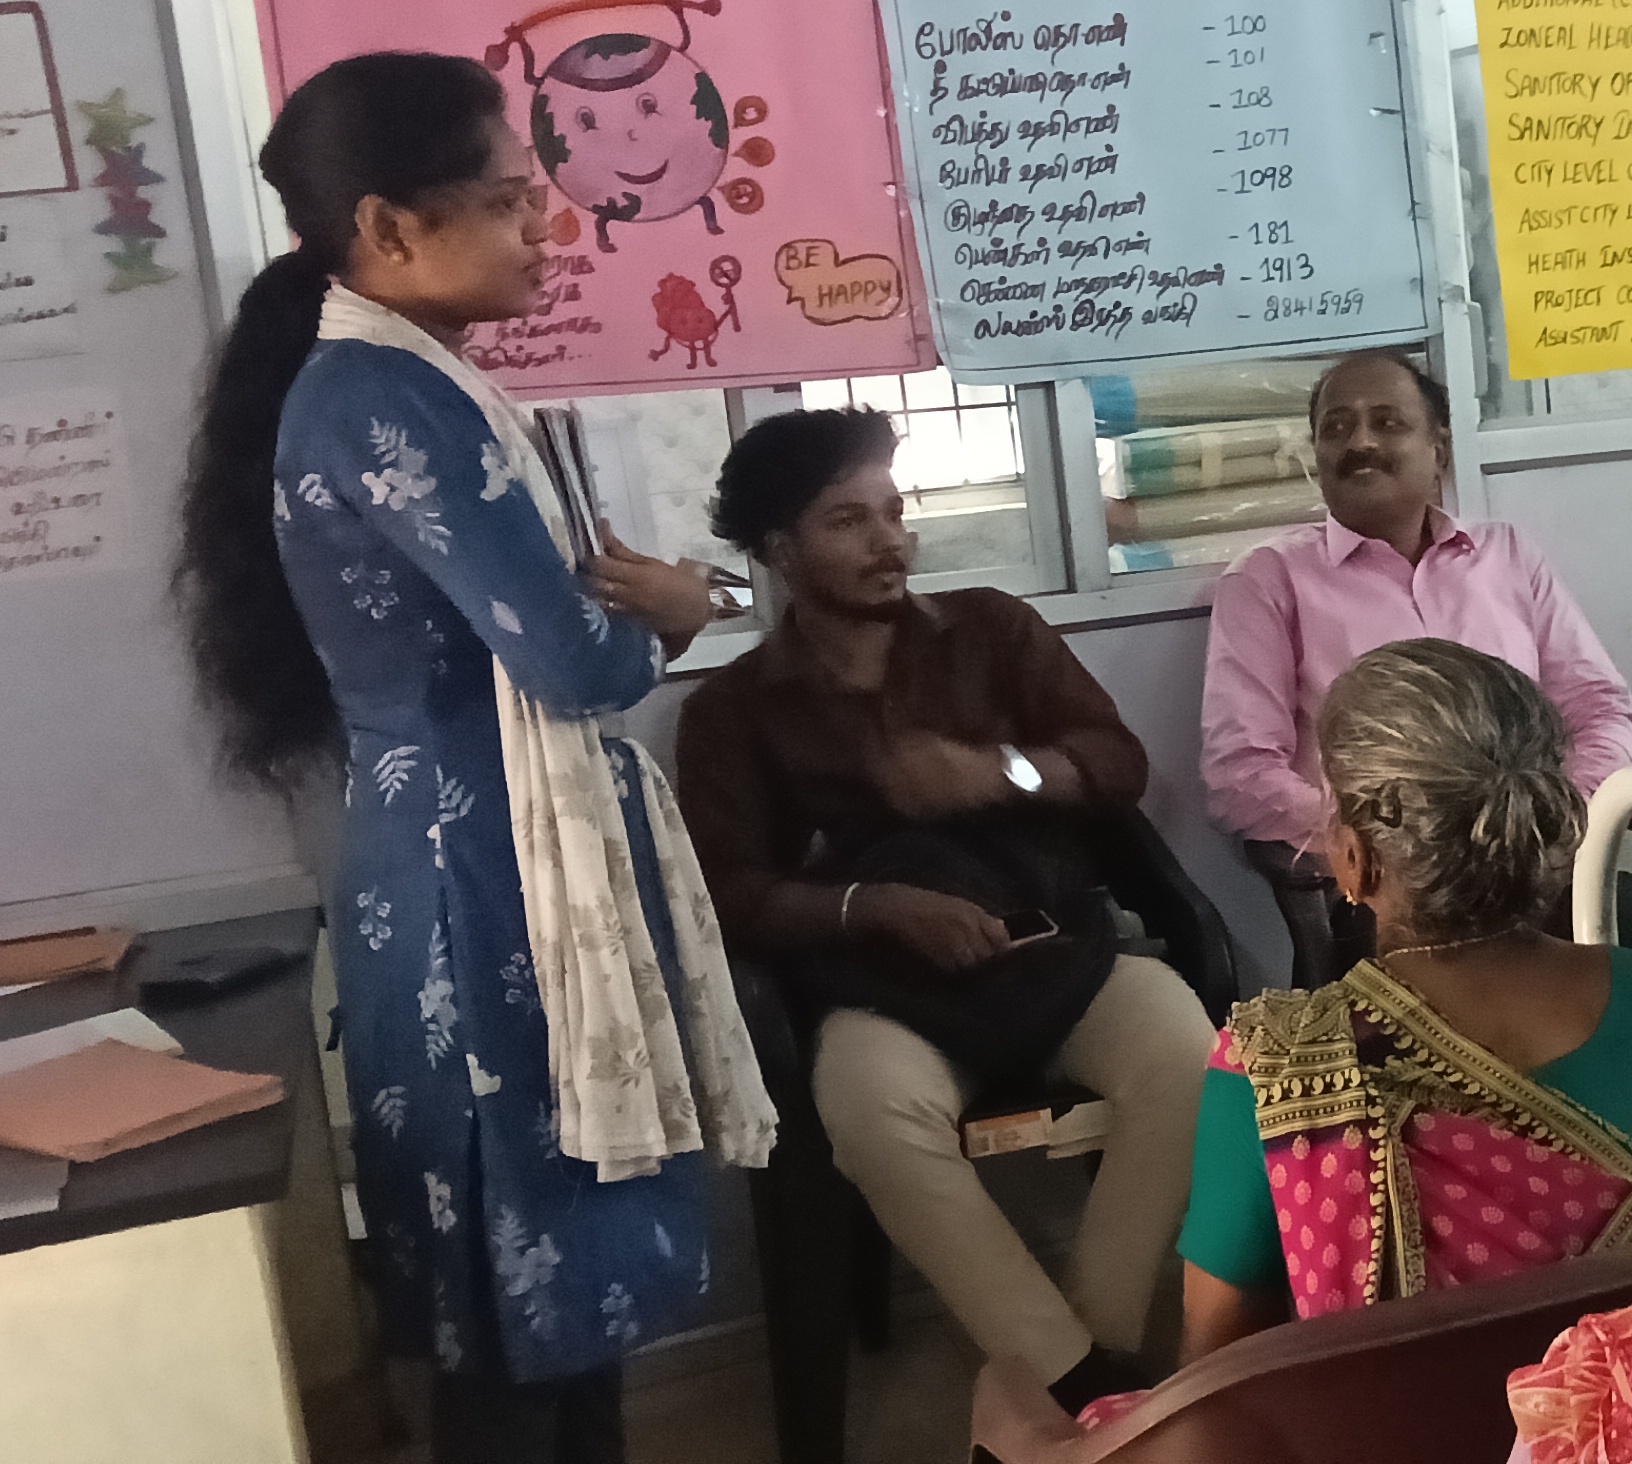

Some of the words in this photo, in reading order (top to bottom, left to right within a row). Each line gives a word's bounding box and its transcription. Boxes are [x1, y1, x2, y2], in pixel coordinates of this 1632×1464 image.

[915, 10, 1024, 59] போலீஸ்
[1225, 14, 1266, 37] 100
[1499, 23, 1577, 50] ZONEAL
[1227, 46, 1265, 68] 101
[1230, 86, 1273, 109] 108
[1504, 67, 1602, 102] SANITORY
[1237, 127, 1290, 151] 1077
[1507, 112, 1606, 147] SANITORY
[1231, 164, 1294, 194] 1098
[1514, 158, 1555, 188] CITY
[1561, 158, 1620, 184] LEVEL
[1248, 220, 1295, 246] 181
[785, 245, 820, 271] BE
[1259, 252, 1315, 283] 1913
[817, 279, 893, 309] HAPPY
[1534, 285, 1607, 315] PROJECT
[1535, 319, 1625, 350] ASSISTANT
